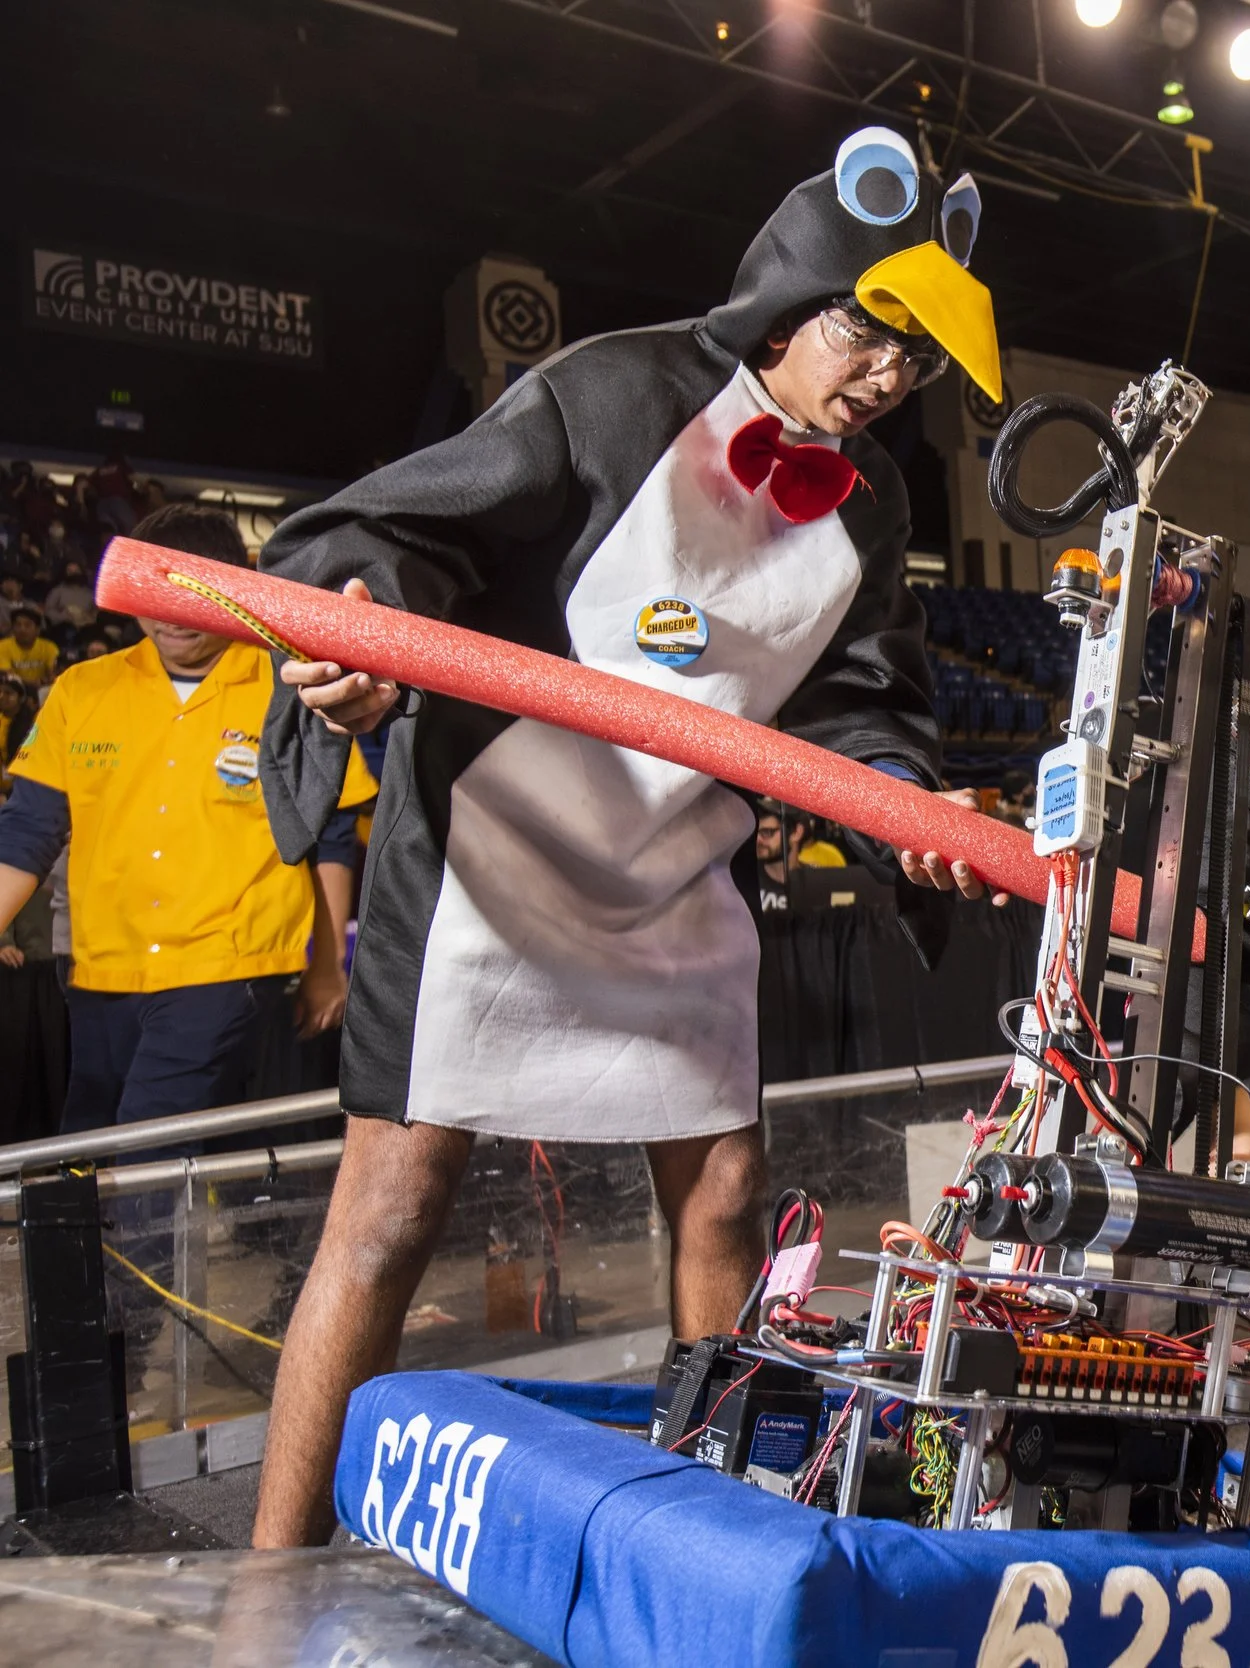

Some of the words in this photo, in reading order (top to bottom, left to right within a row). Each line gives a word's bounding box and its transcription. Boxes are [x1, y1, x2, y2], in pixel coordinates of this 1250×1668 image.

[95, 259, 311, 319] PROVIDENT
[95, 287, 205, 320] CREDIT
[220, 307, 312, 336] UNION
[35, 297, 117, 327] EVENT
[124, 312, 218, 344] CENTER
[224, 327, 251, 348] AT
[258, 332, 313, 358] SJSU
[658, 600, 685, 611] 6238
[646, 619, 684, 635] CHARGED
[685, 616, 697, 629] UP
[658, 645, 685, 653] COACH
[1157, 1247, 1202, 1260] POWER
[768, 1419, 805, 1431] AndyMark
[1016, 1424, 1042, 1465] NEO
[361, 1412, 509, 1597] 6238
